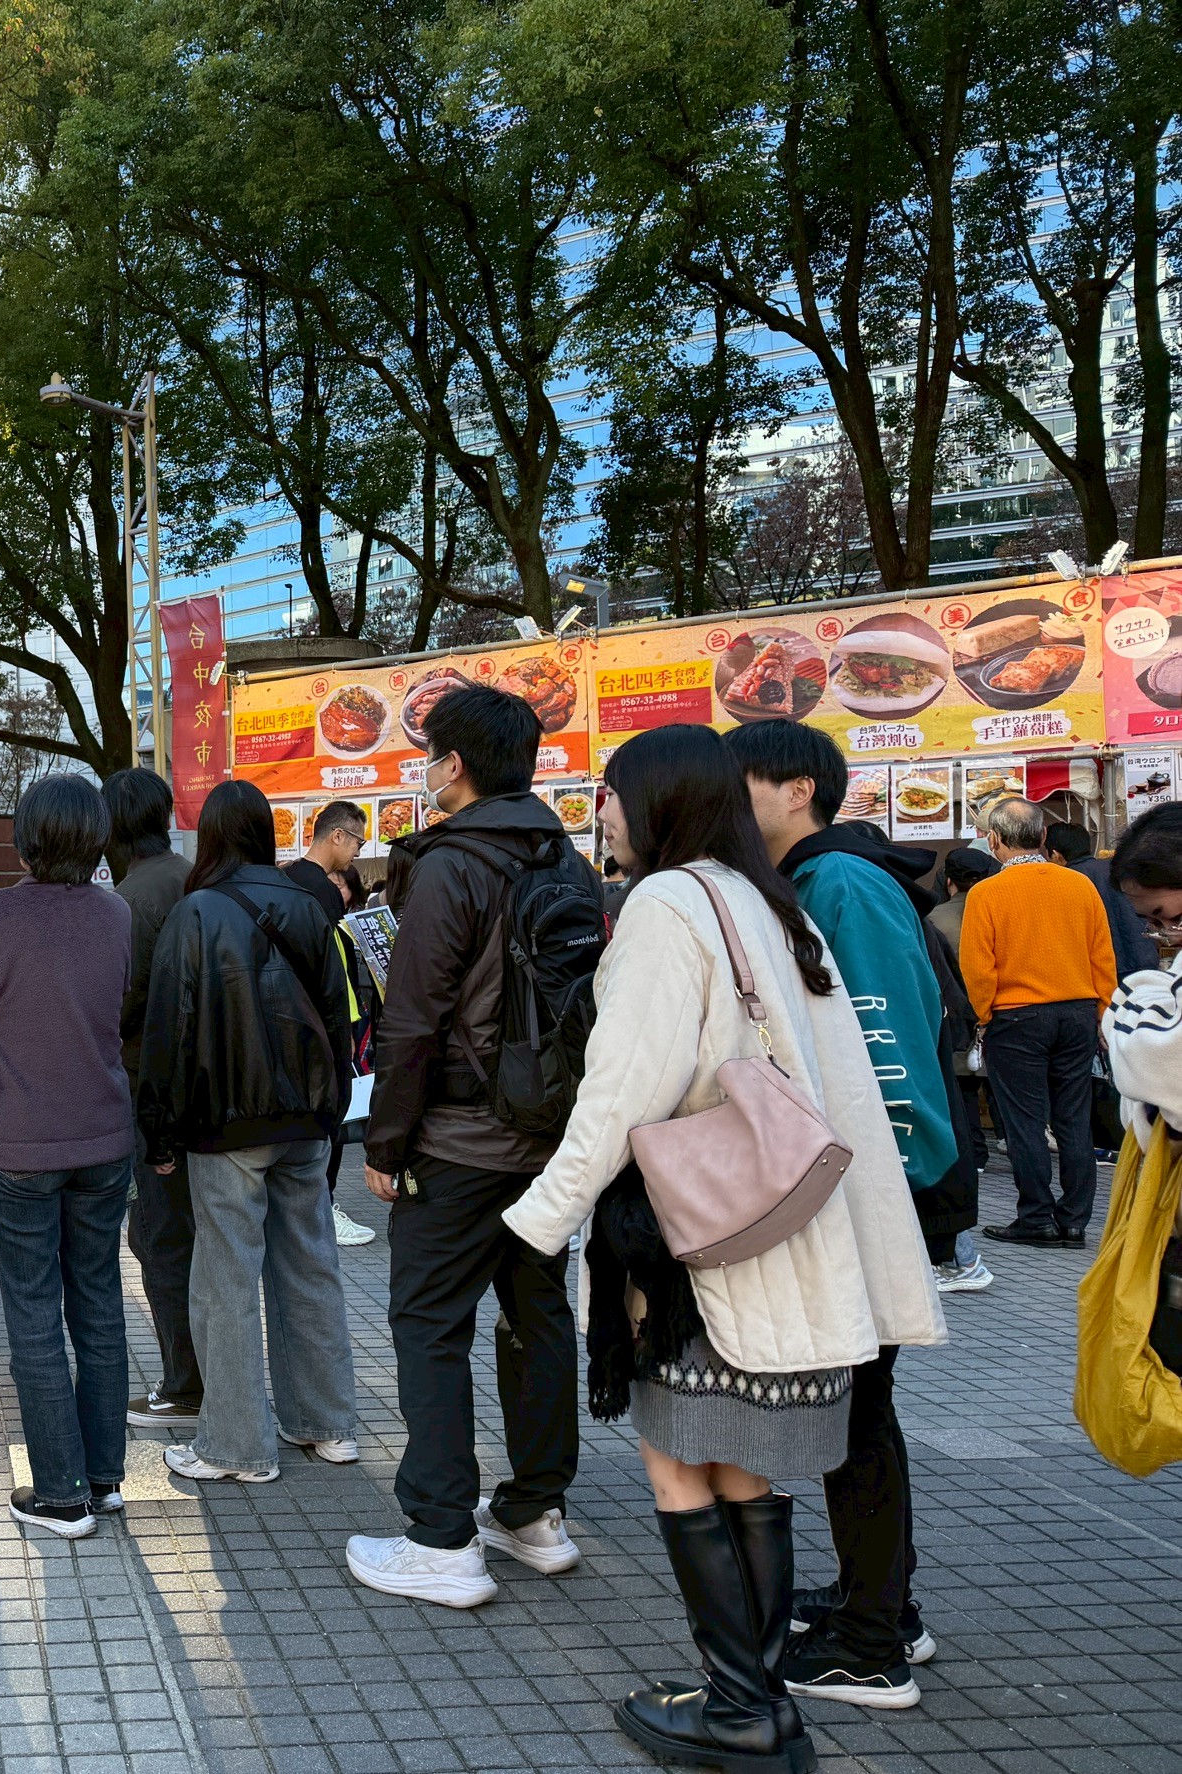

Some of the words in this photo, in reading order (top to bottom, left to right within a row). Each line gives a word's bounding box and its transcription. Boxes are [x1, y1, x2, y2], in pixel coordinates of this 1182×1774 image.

[711, 634, 726, 648] 台
[822, 622, 838, 637] 湾
[948, 609, 965, 624] 美
[1071, 591, 1088, 606] 食
[1115, 619, 1151, 633] サクサク
[315, 681, 326, 694] 台
[479, 661, 492, 675] 美
[564, 648, 577, 660] 食
[675, 667, 696, 677] 台湾
[599, 669, 672, 693] 台北四季
[621, 693, 677, 707] 0567-32-4988
[237, 713, 289, 732] 台北四季
[991, 713, 1052, 726] 手作り大根餅
[1153, 715, 1182, 726] タロ
[859, 724, 914, 734] 台湾バーガー
